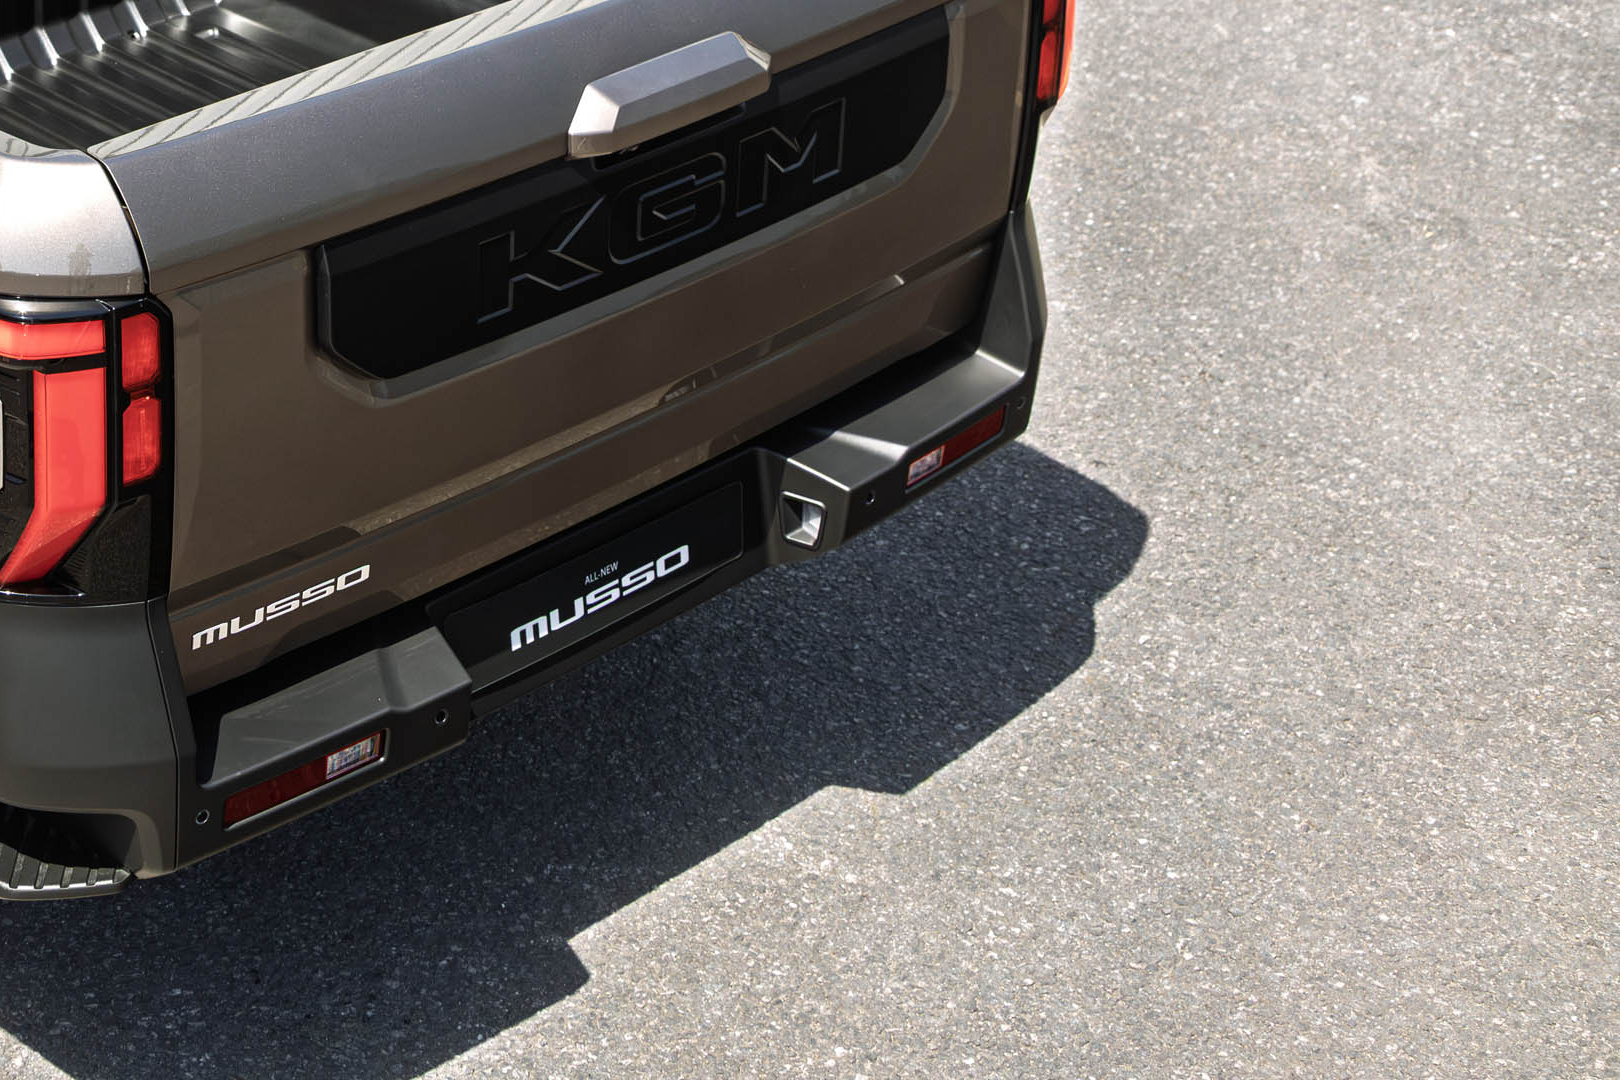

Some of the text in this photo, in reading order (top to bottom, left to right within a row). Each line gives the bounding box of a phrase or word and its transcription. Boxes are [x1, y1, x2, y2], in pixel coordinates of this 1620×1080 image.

[477, 97, 846, 324] KGM
[191, 564, 370, 651] MUSSO
[510, 544, 690, 652] MUSSO
[584, 560, 619, 586] ALL-NEW
